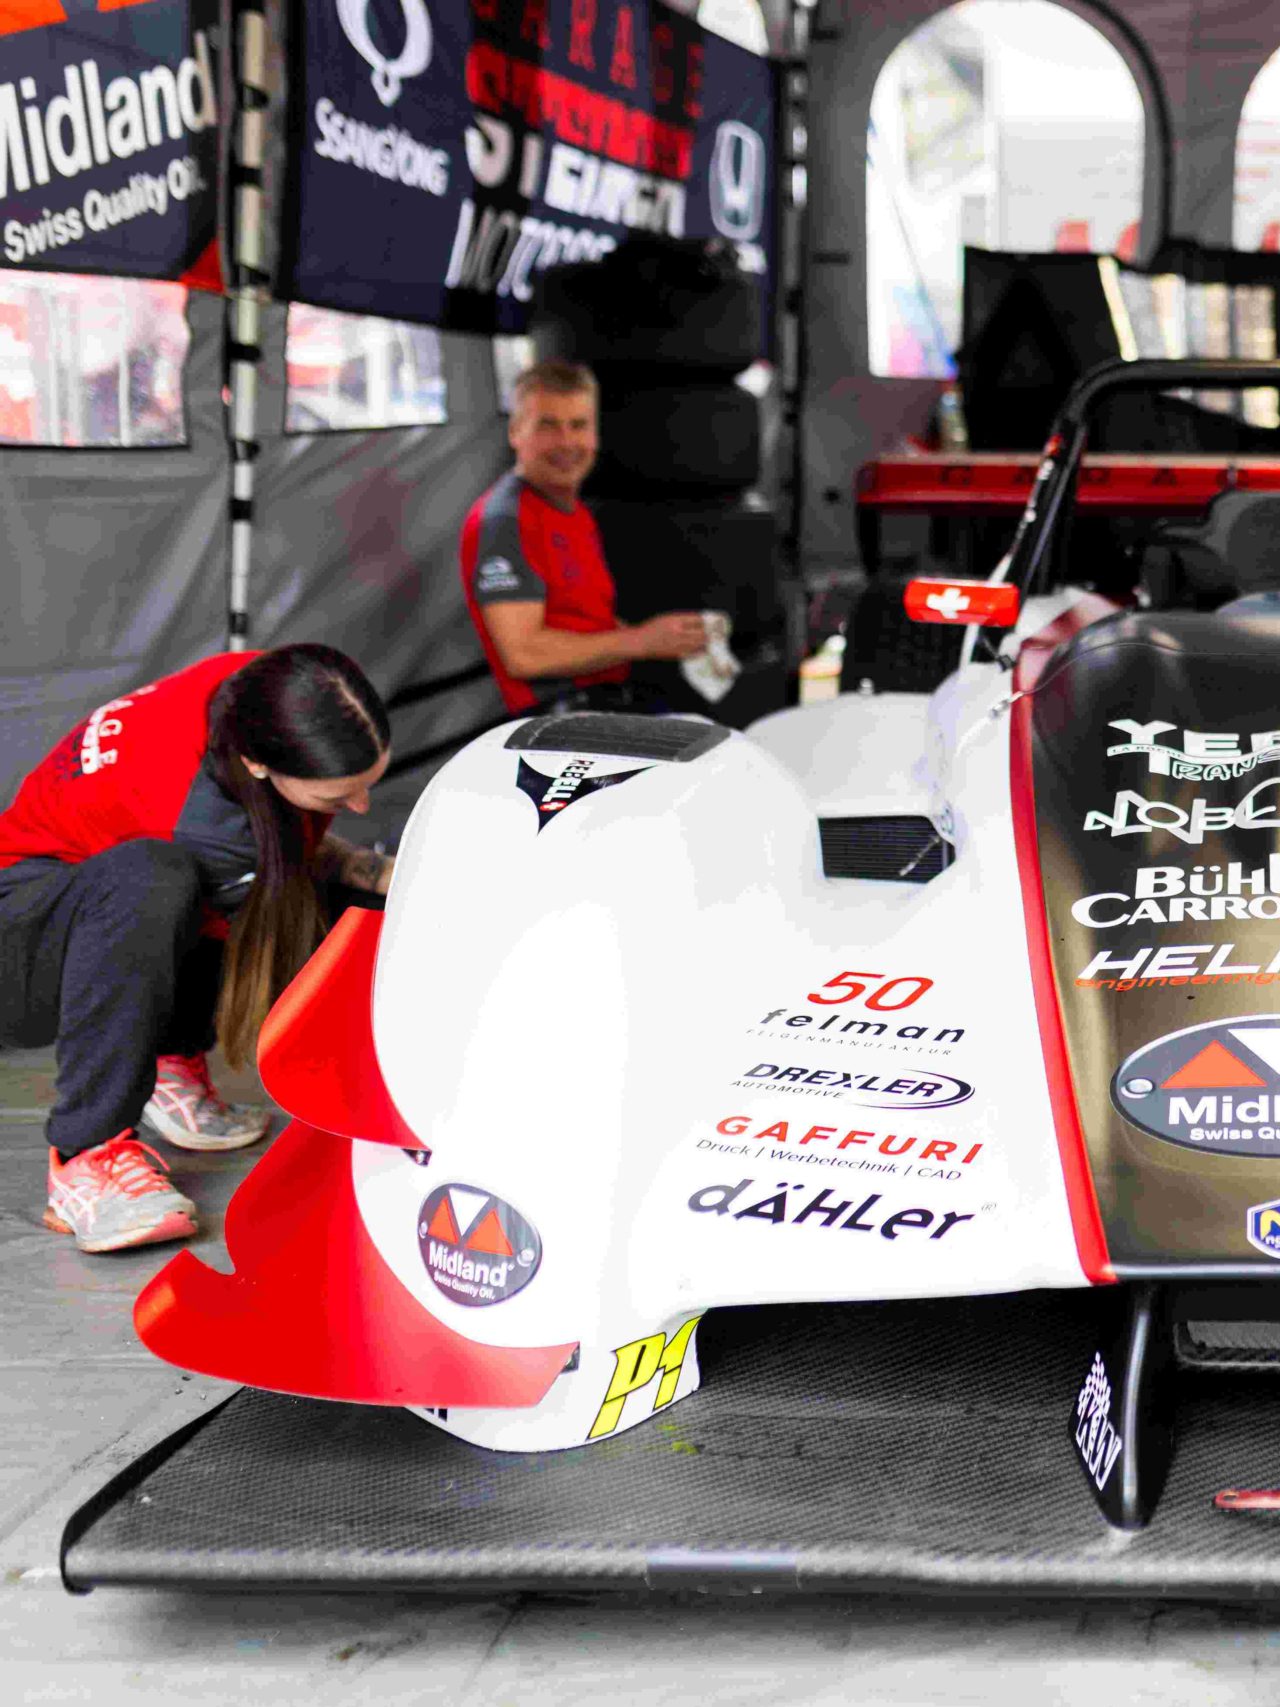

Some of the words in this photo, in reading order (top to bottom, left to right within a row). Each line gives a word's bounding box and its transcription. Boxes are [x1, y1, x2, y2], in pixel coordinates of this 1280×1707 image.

[4, 207, 84, 263] Swiss
[83, 172, 168, 232] Quality
[807, 971, 934, 1012] 50
[760, 1008, 965, 1043] felman
[729, 1080, 844, 1099] AUTOMOTIVE
[744, 1063, 943, 1098] DREXLER
[716, 1116, 983, 1164] GAFFURI
[1189, 1128, 1253, 1141] Swiss
[696, 1138, 752, 1157] Druck
[769, 1148, 899, 1174] Werbetechnik
[917, 1168, 962, 1181] CAD
[428, 1241, 508, 1288] Midland
[585, 1317, 702, 1442] P1
